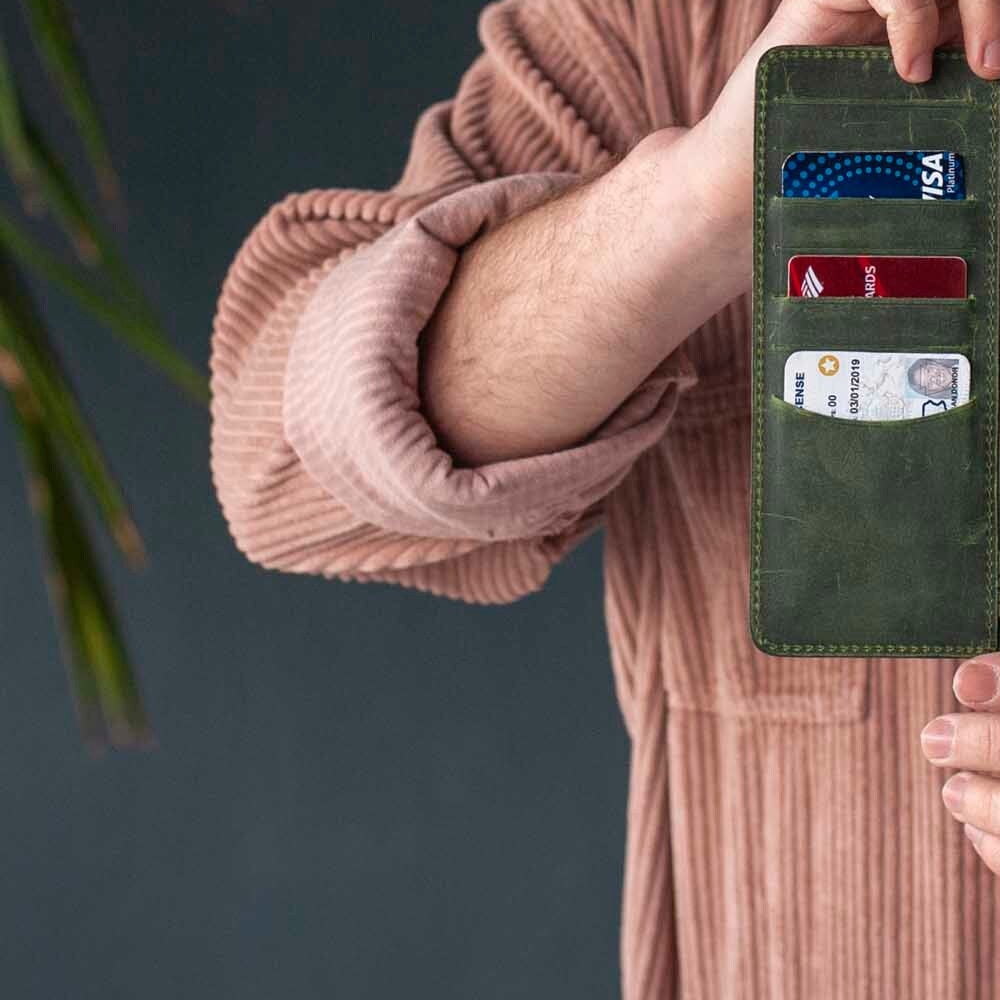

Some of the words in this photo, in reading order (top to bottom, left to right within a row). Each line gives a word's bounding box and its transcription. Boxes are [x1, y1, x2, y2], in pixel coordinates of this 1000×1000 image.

[946, 152, 956, 193] Platinum
[794, 372, 805, 410] ENSE
[850, 358, 860, 414] 03/01/2019
